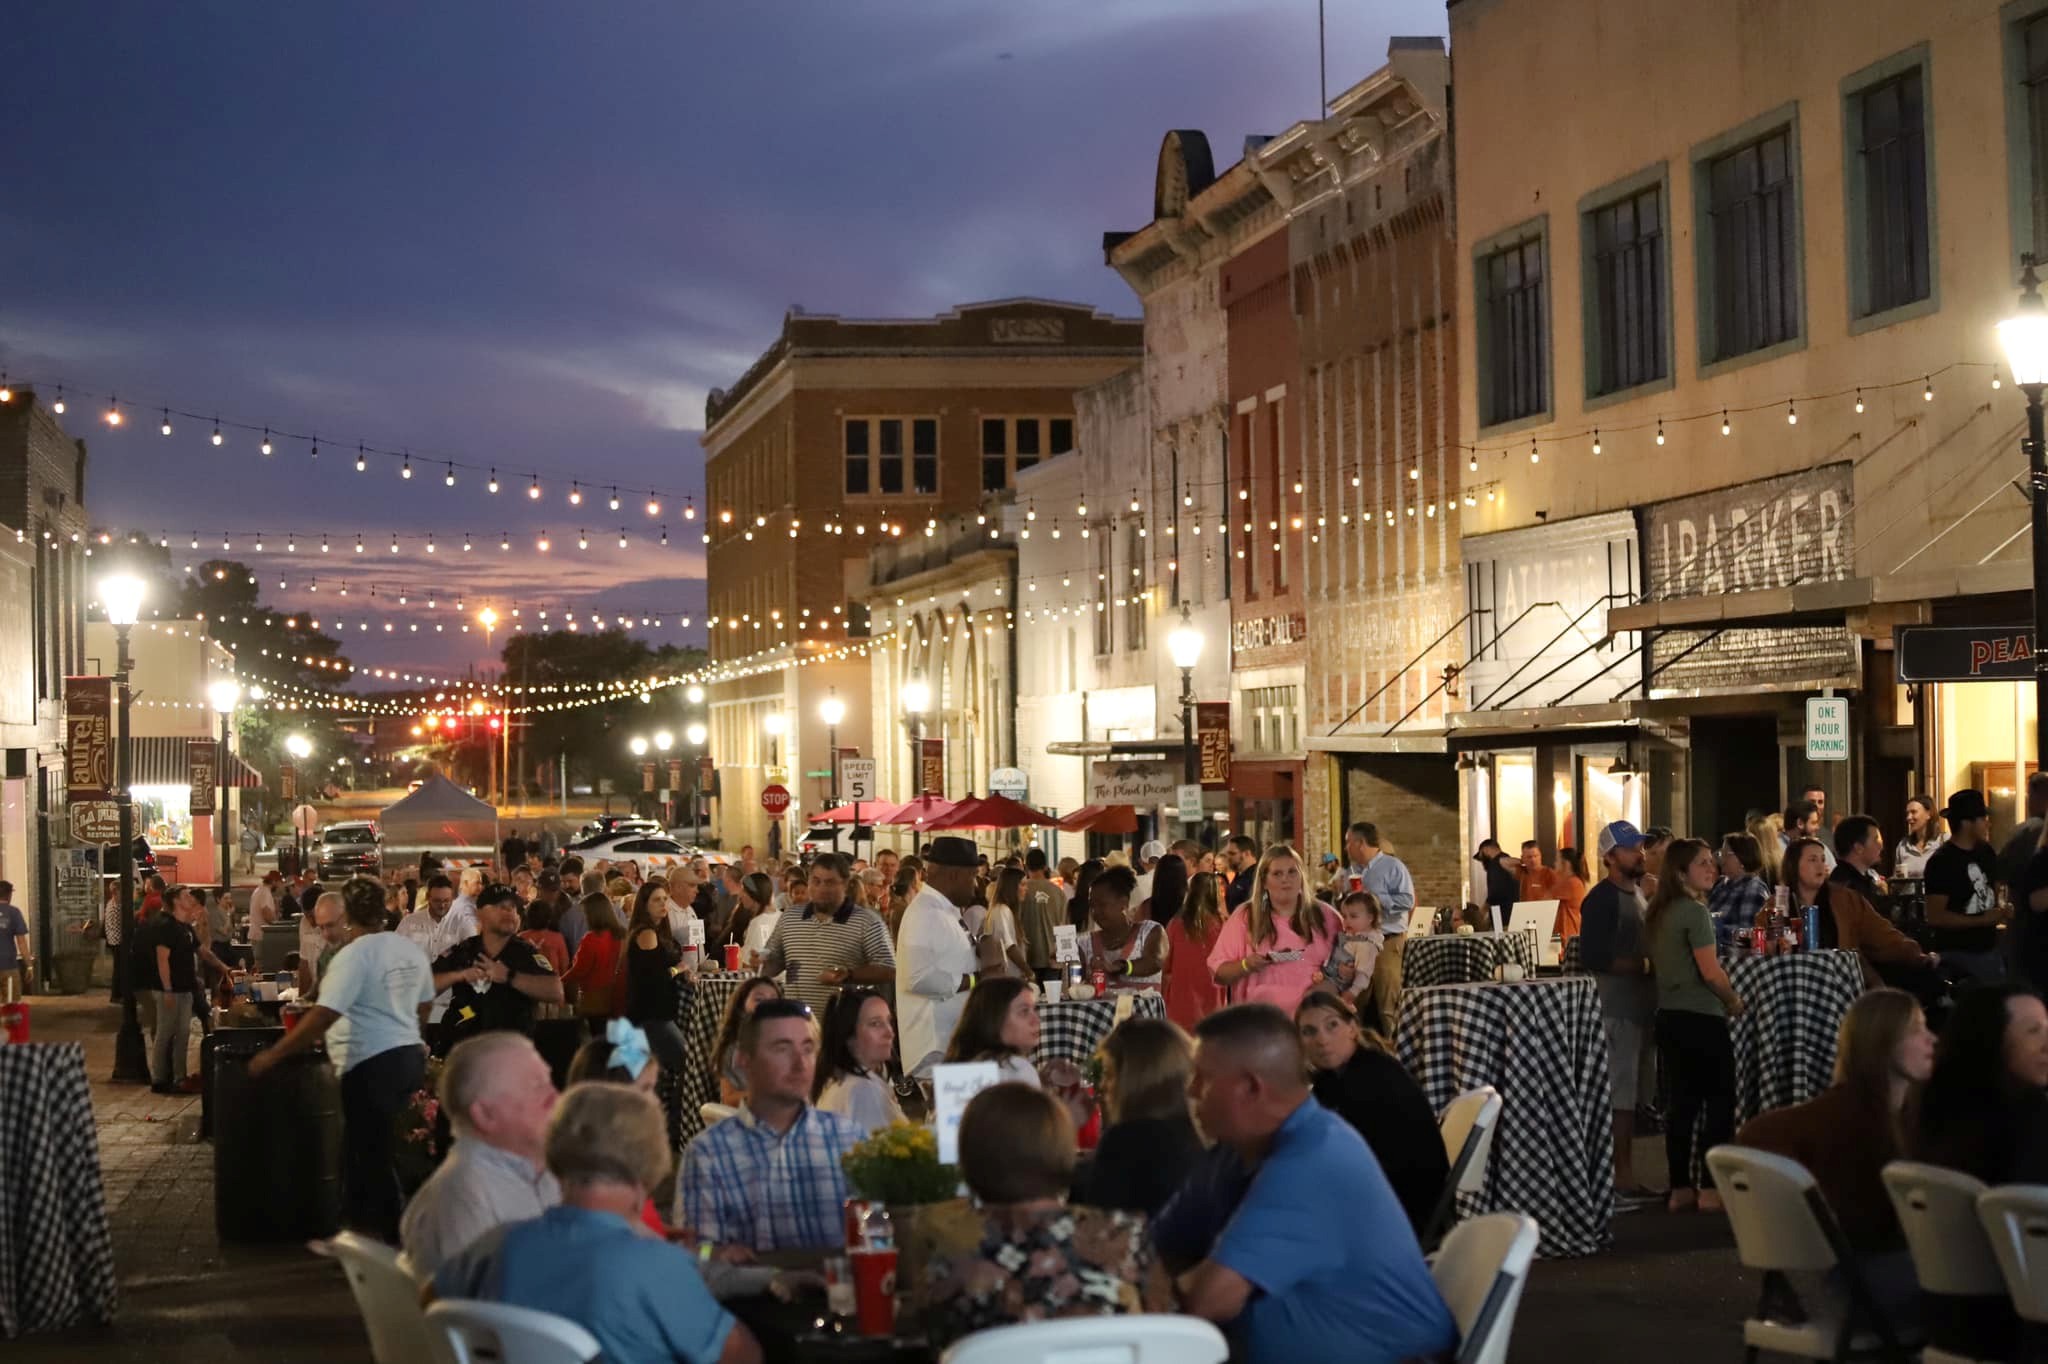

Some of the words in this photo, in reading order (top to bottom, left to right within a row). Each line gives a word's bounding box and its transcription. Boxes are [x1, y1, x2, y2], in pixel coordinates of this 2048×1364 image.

[1678, 489, 1846, 597] PARKER
[1969, 635, 2036, 675] PEA
[1817, 706, 1836, 719] ONE
[1815, 723, 1840, 735] HOUR
[1810, 740, 1845, 752] PARKING
[844, 763, 872, 771] SPEED
[847, 772, 869, 780] LIMIT
[853, 782, 865, 798] 5
[763, 793, 788, 805] STOP
